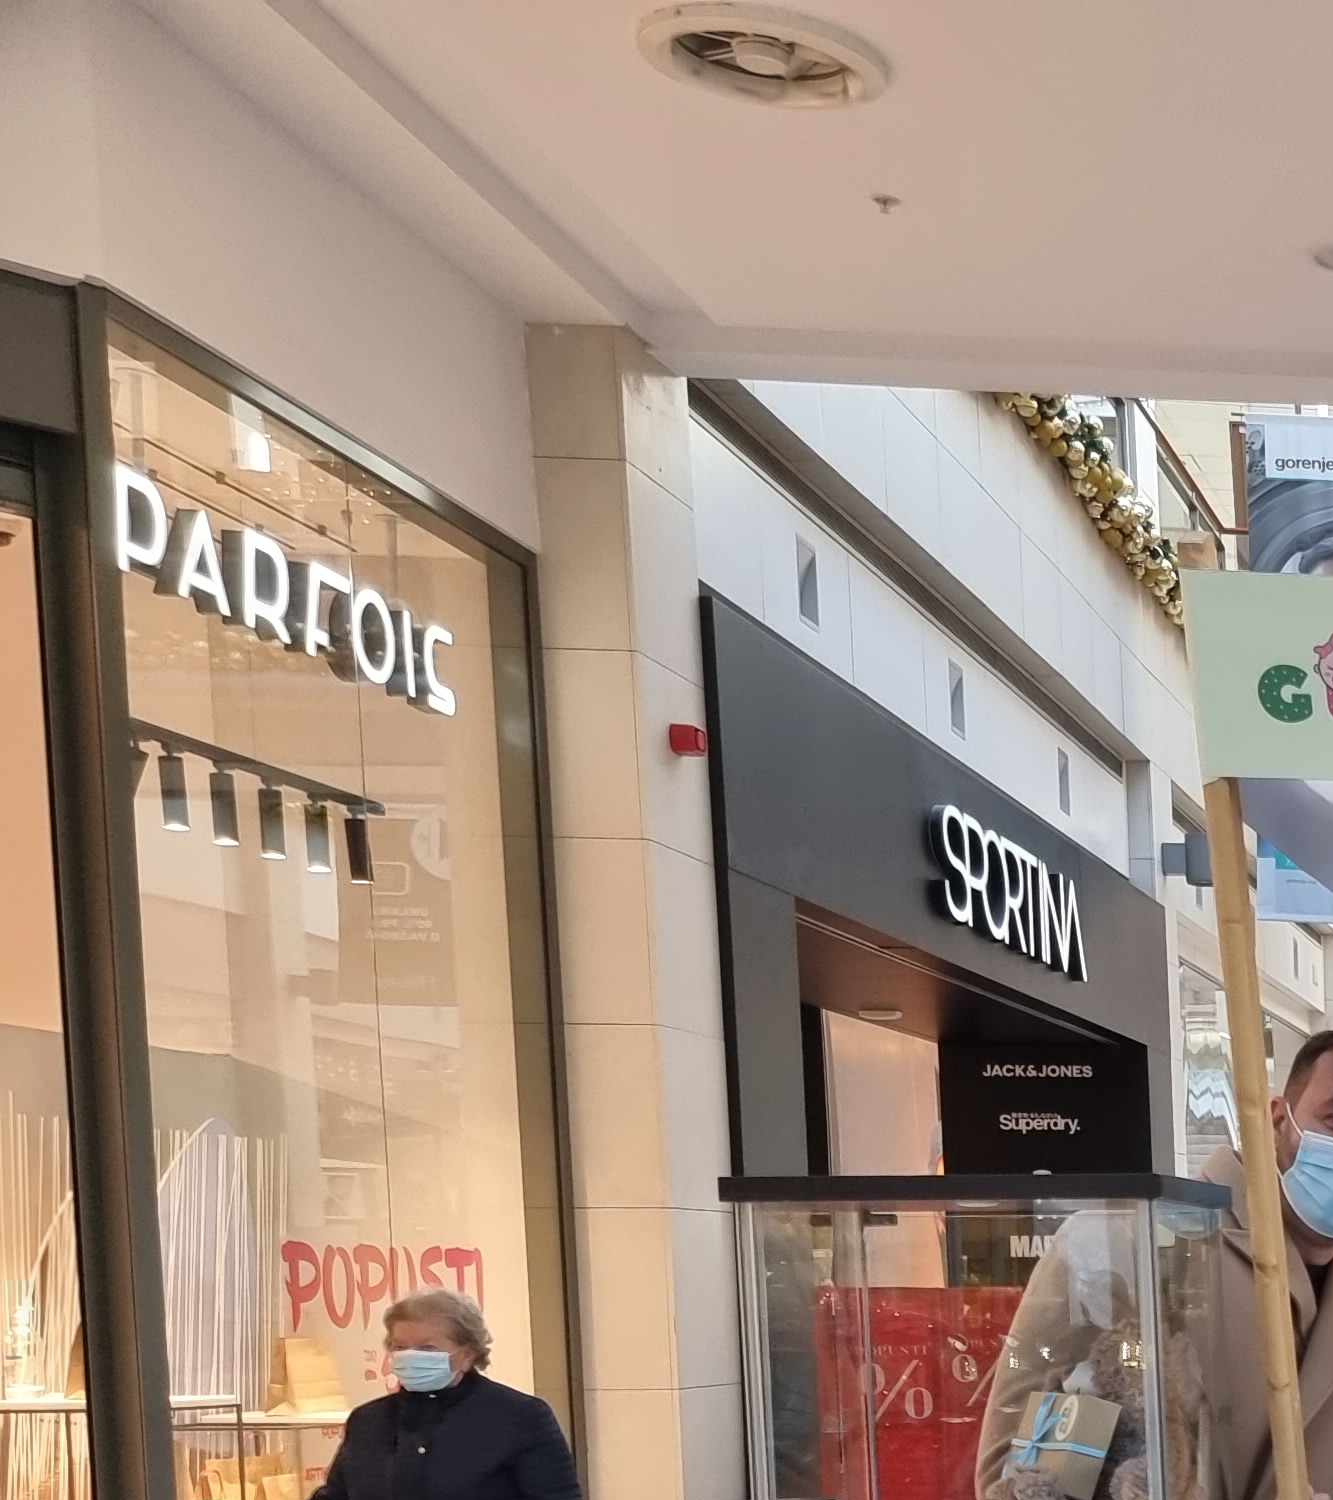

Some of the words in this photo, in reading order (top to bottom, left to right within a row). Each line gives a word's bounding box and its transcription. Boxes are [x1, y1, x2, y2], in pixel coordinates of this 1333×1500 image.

[114, 463, 457, 716] PARFOIS
[940, 805, 1088, 983] SPORTINA
[982, 1063, 1093, 1078] JACK&JONES
[999, 1113, 1081, 1135] Superdry.
[281, 1240, 485, 1333] POPUSTI
